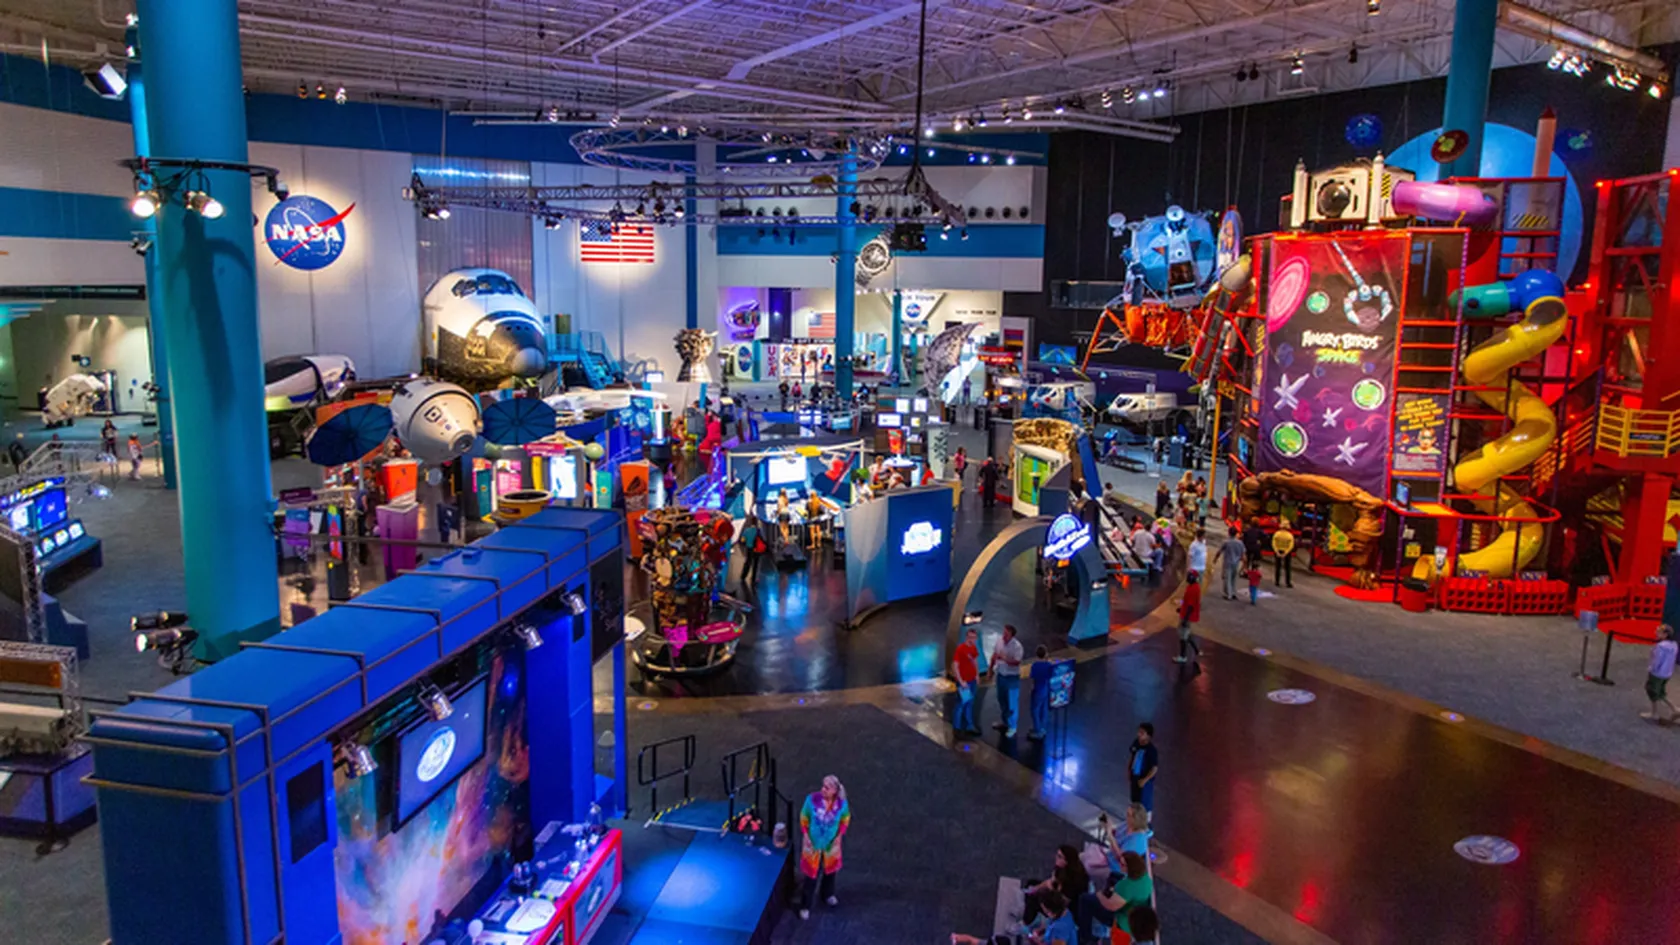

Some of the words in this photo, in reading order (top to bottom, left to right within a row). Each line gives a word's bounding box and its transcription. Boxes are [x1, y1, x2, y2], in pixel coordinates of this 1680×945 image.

[271, 224, 342, 242] NASA
[1301, 330, 1341, 348] ANGRY
[1341, 333, 1379, 350] BIRDS
[1315, 345, 1362, 364] SPACE
